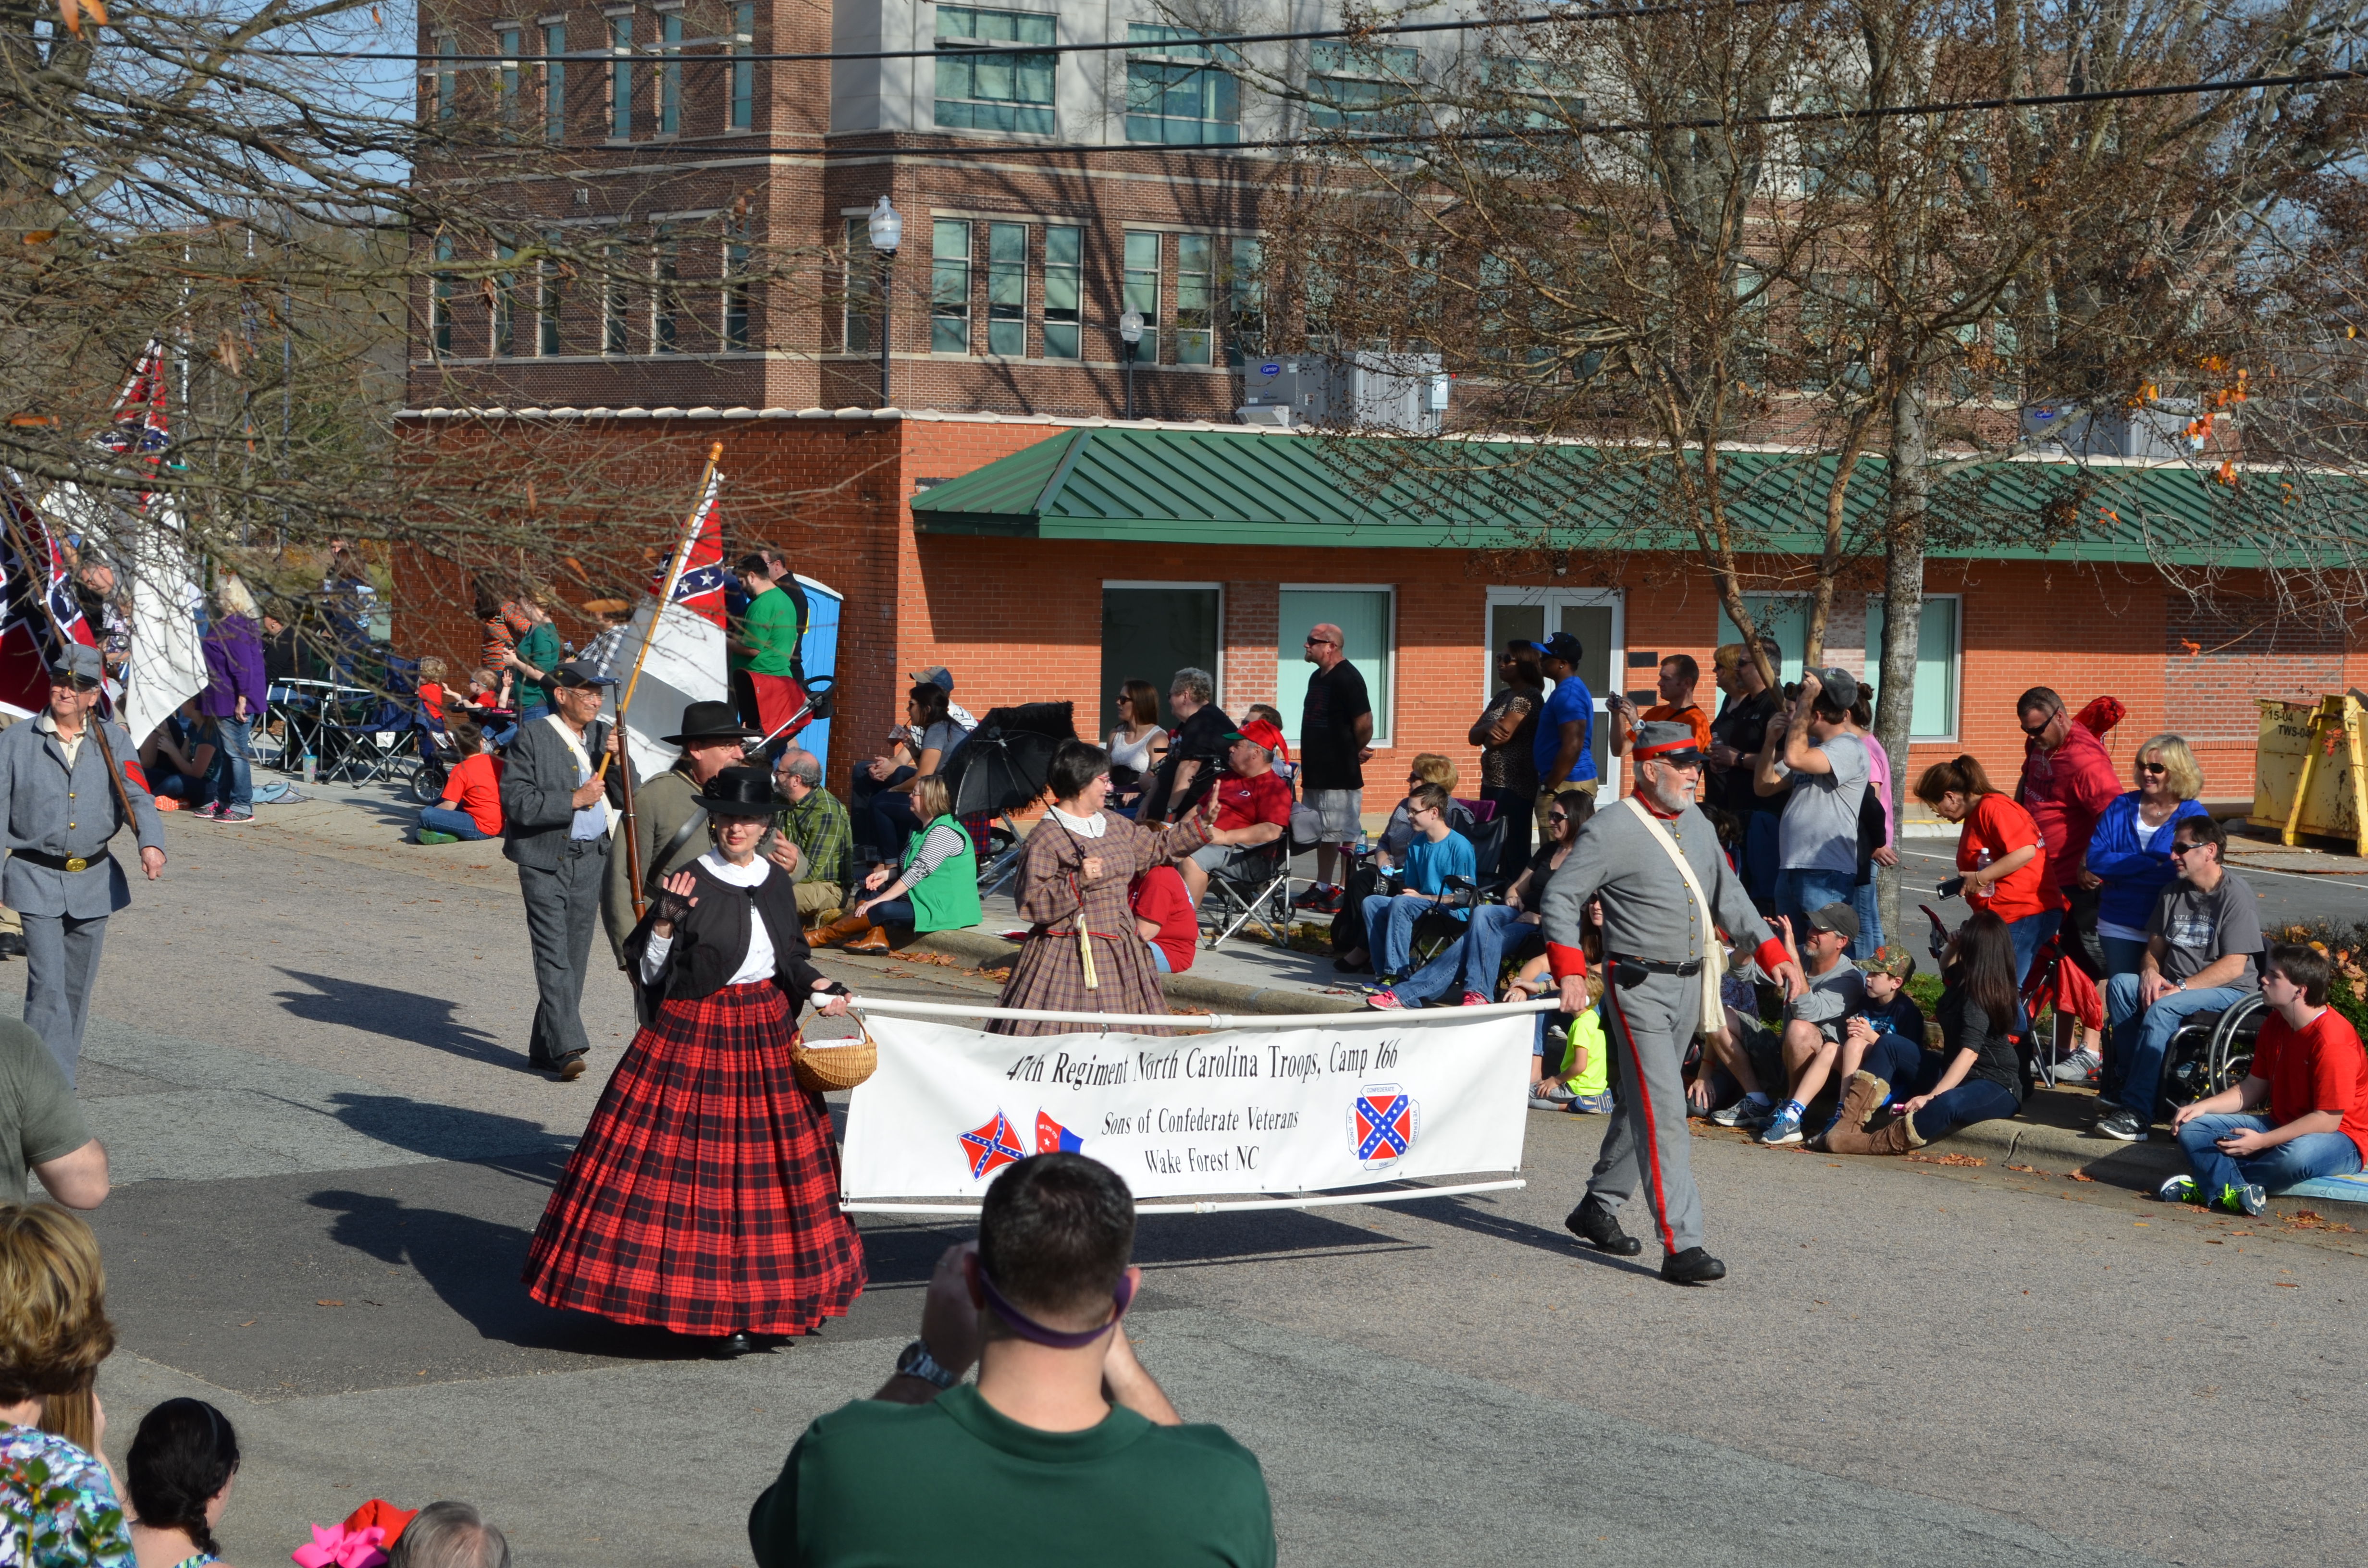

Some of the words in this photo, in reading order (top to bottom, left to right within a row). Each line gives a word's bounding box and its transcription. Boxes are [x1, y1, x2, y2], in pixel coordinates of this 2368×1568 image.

[2268, 710, 2294, 723] 15-04
[2278, 724, 2311, 738] TWS-04
[1006, 1054, 1045, 1082] 47th
[1050, 1052, 1129, 1091] Regiment
[1133, 1049, 1178, 1082] North
[1186, 1045, 1258, 1078] Carolina
[1268, 1045, 1321, 1083] Troops,
[1330, 1041, 1368, 1078] Camp
[1374, 1038, 1401, 1069] 166
[1101, 1112, 1131, 1135] Sons
[1138, 1109, 1151, 1133] of
[1159, 1107, 1239, 1133] Confederate
[1248, 1106, 1299, 1131] Veterans
[1348, 1115, 1353, 1124] OF
[1145, 1150, 1182, 1175] Wake
[1188, 1148, 1229, 1172] Forest
[1236, 1146, 1259, 1170] NC
